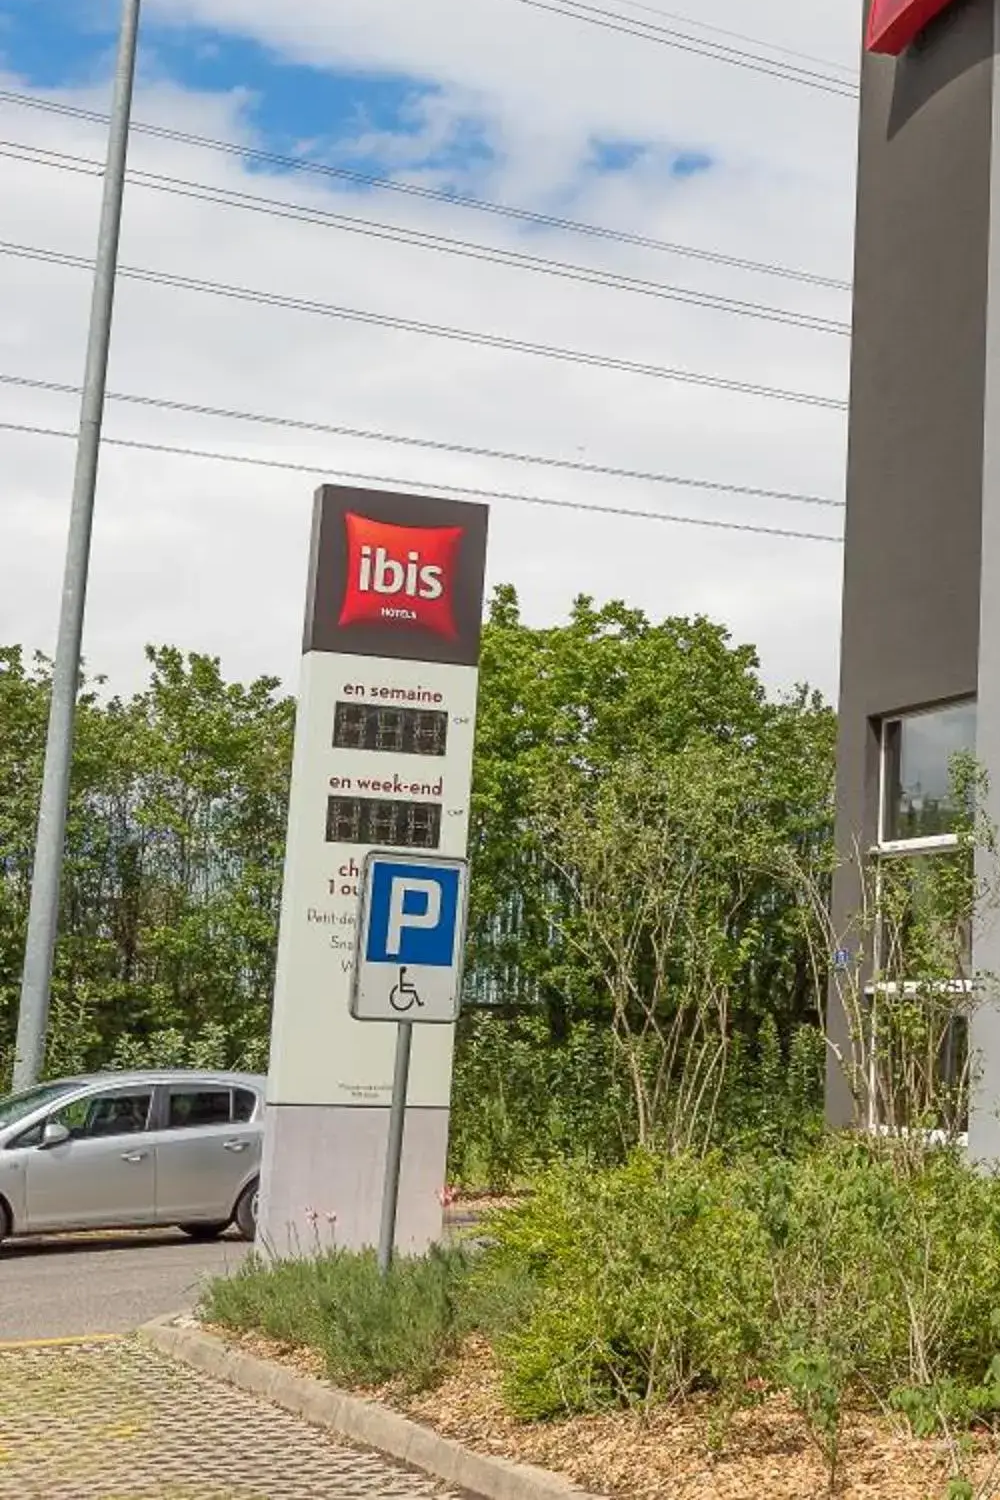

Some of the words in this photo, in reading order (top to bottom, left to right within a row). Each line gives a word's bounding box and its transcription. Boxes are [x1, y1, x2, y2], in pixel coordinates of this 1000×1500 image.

[359, 545, 443, 599] ibis
[381, 607, 417, 619] HOTELS
[343, 683, 365, 696] en
[369, 685, 443, 703] semaine
[328, 776, 351, 789] en
[357, 773, 443, 795] week-end
[385, 876, 442, 956] P
